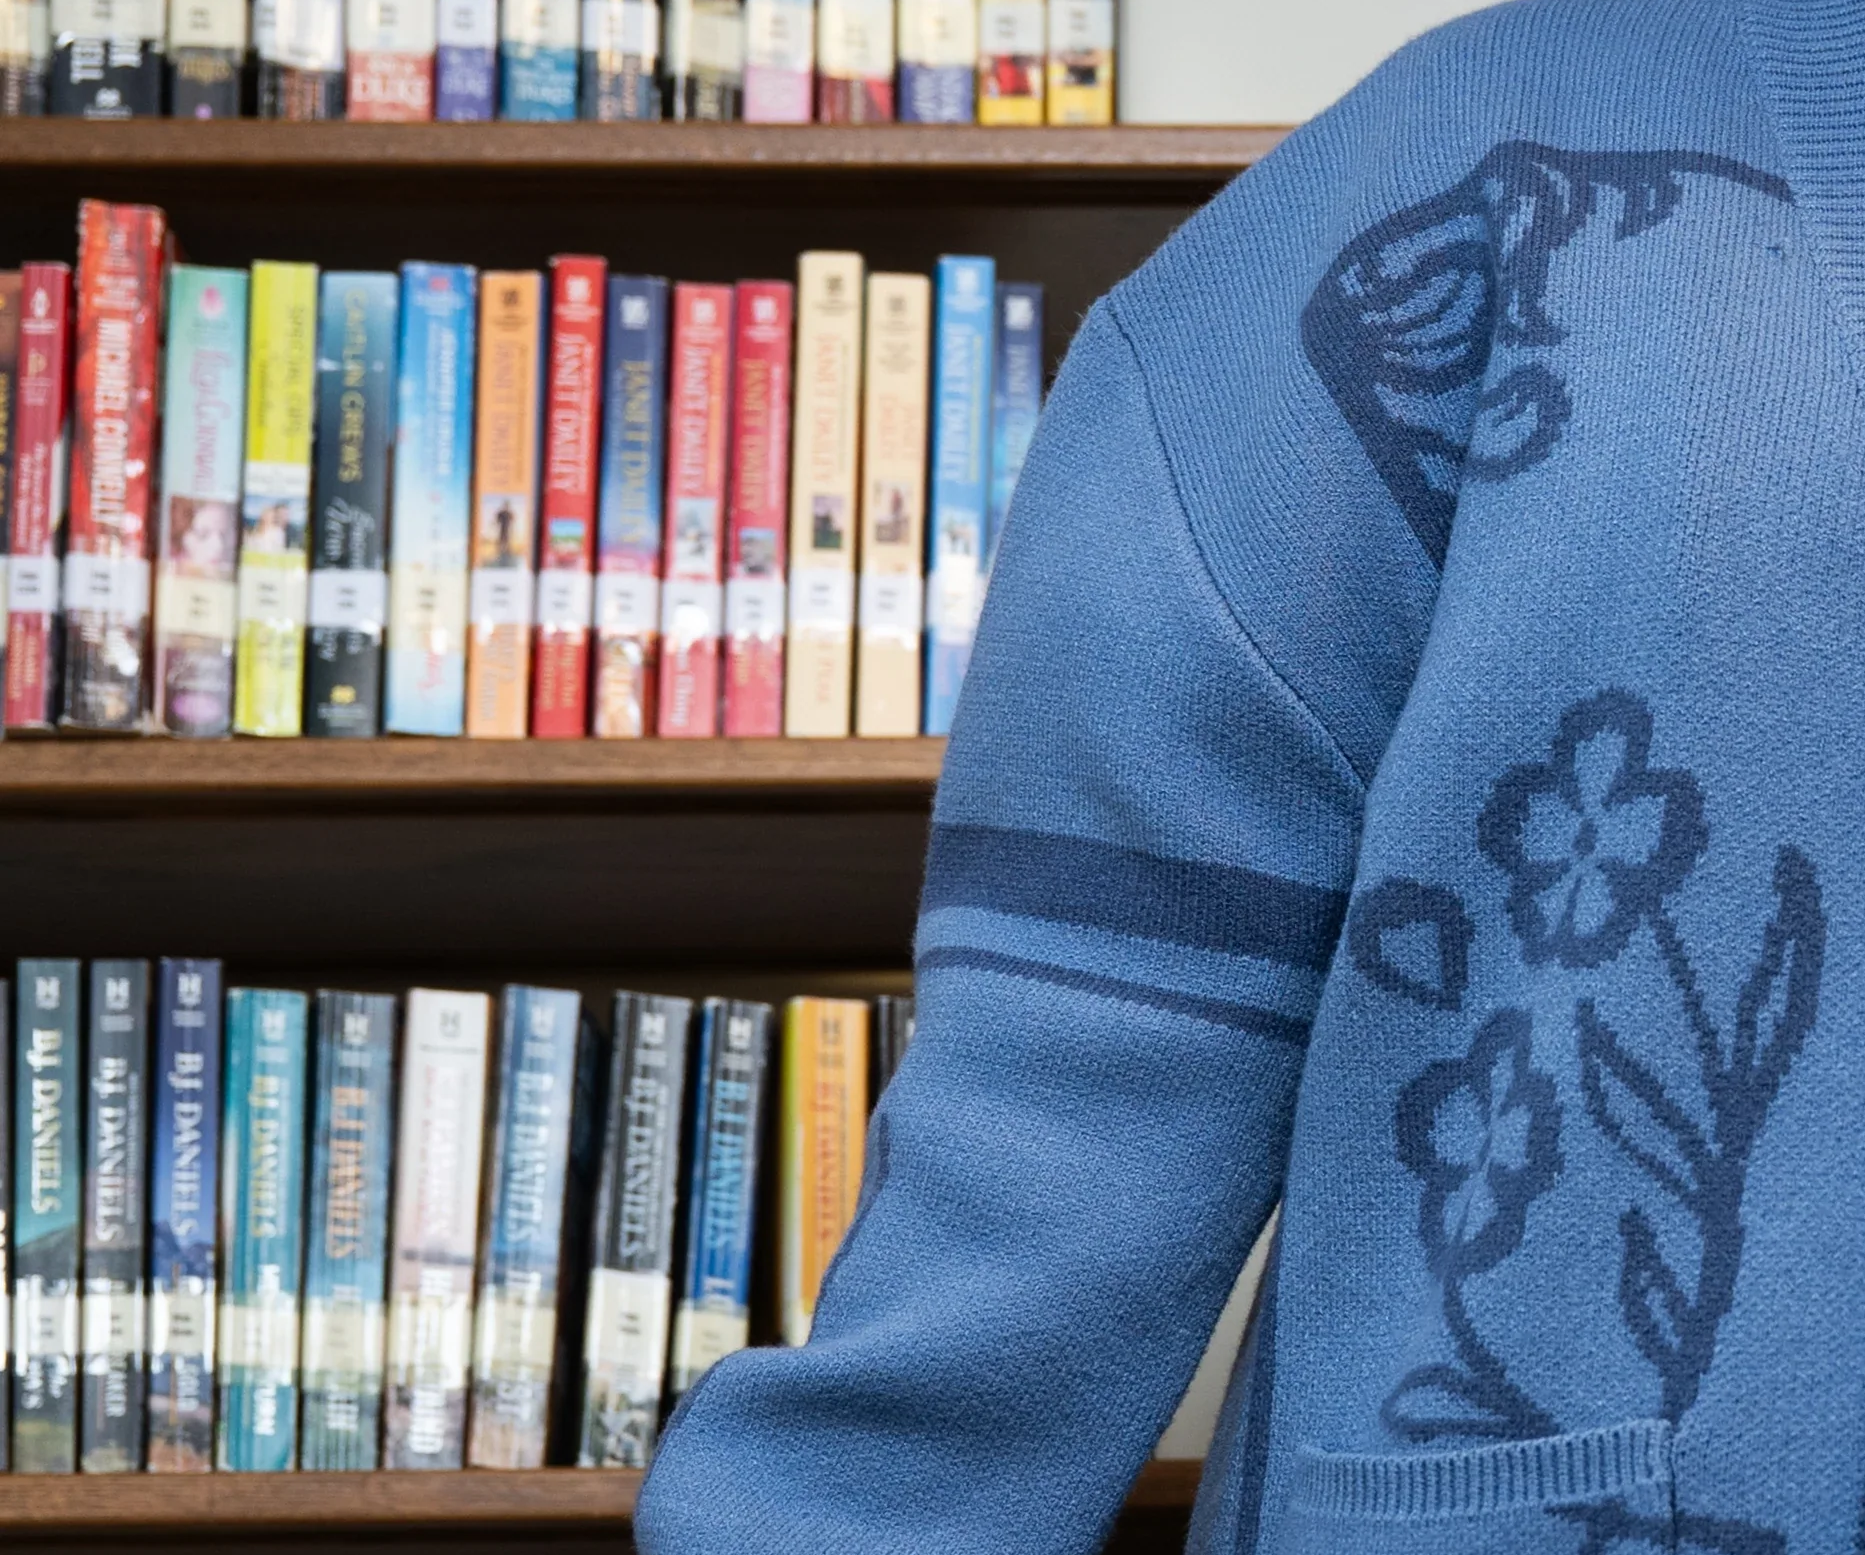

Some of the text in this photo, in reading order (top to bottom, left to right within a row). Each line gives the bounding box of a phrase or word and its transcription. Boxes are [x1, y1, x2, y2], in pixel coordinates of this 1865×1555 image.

[91, 318, 131, 529] MICHAEL CONNELLY
[339, 392, 364, 483] CREWS
[29, 1078, 64, 1215] DANIELS
[94, 1105, 128, 1244] DANIELS
[168, 1101, 203, 1238] DANIELS
[618, 1126, 652, 1258] DANIELS
